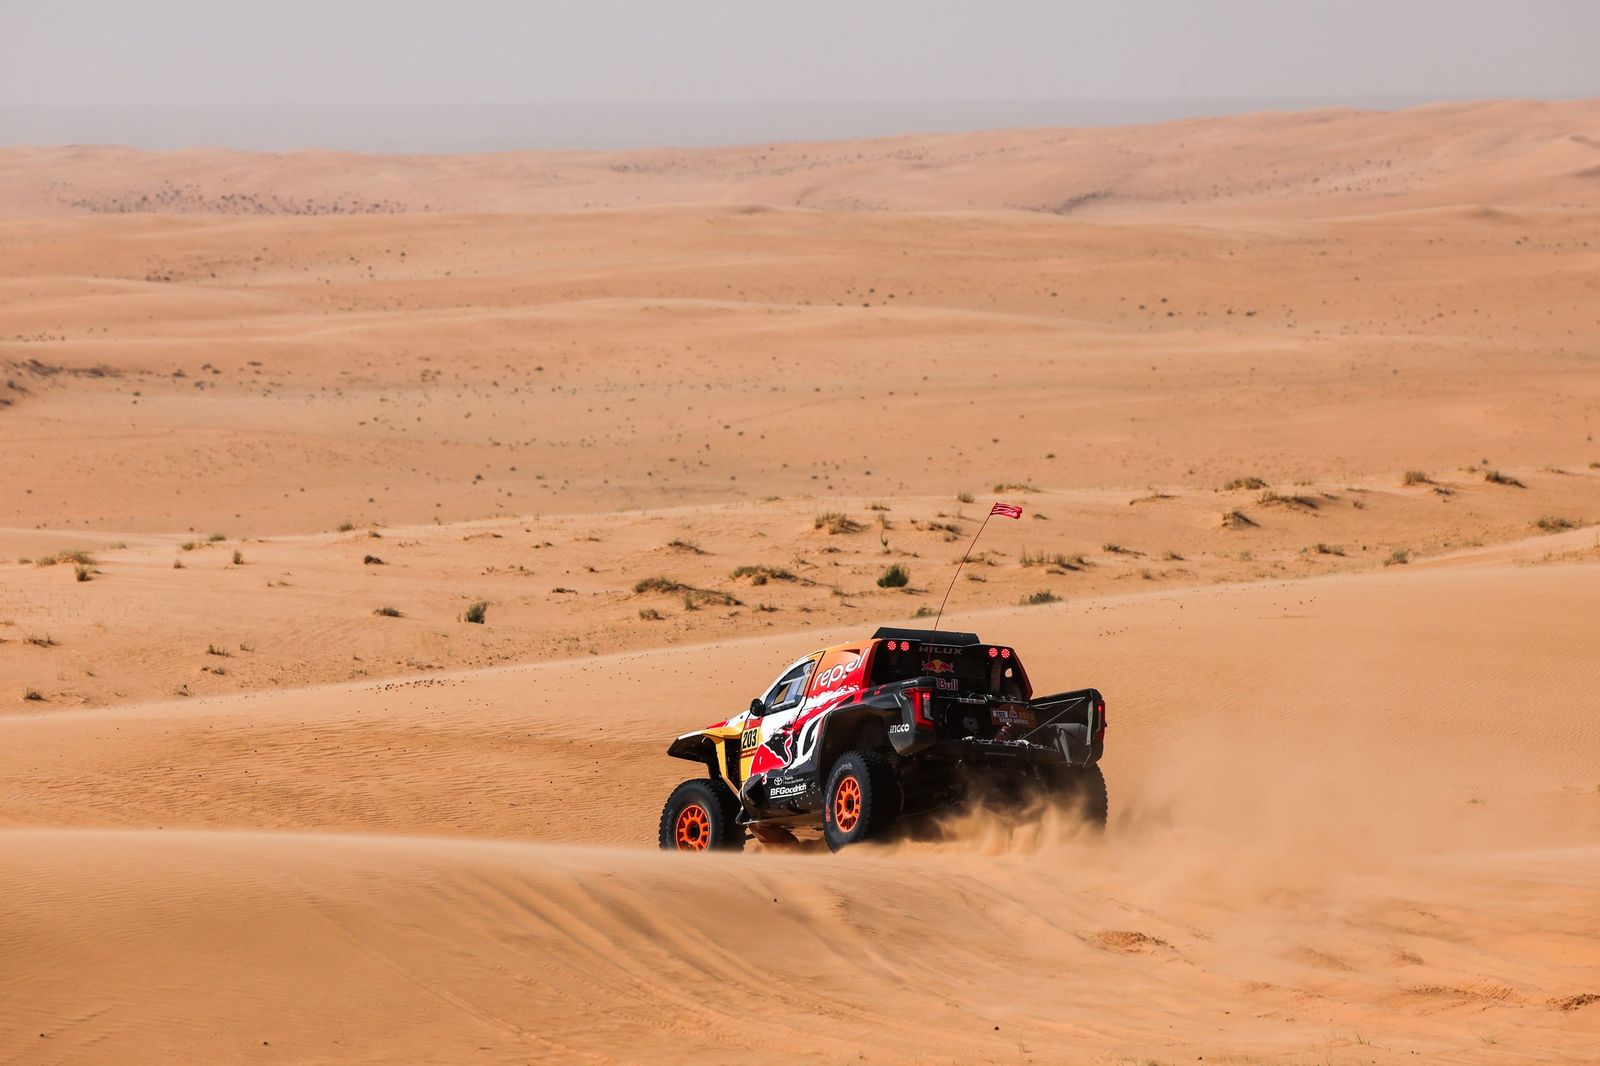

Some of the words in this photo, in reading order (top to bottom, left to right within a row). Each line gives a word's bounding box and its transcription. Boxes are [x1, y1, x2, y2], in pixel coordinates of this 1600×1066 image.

[919, 646, 962, 655] HILUX
[937, 678, 959, 691] Bull
[742, 729, 757, 749] 203
[770, 783, 806, 797] BFGoodrich
